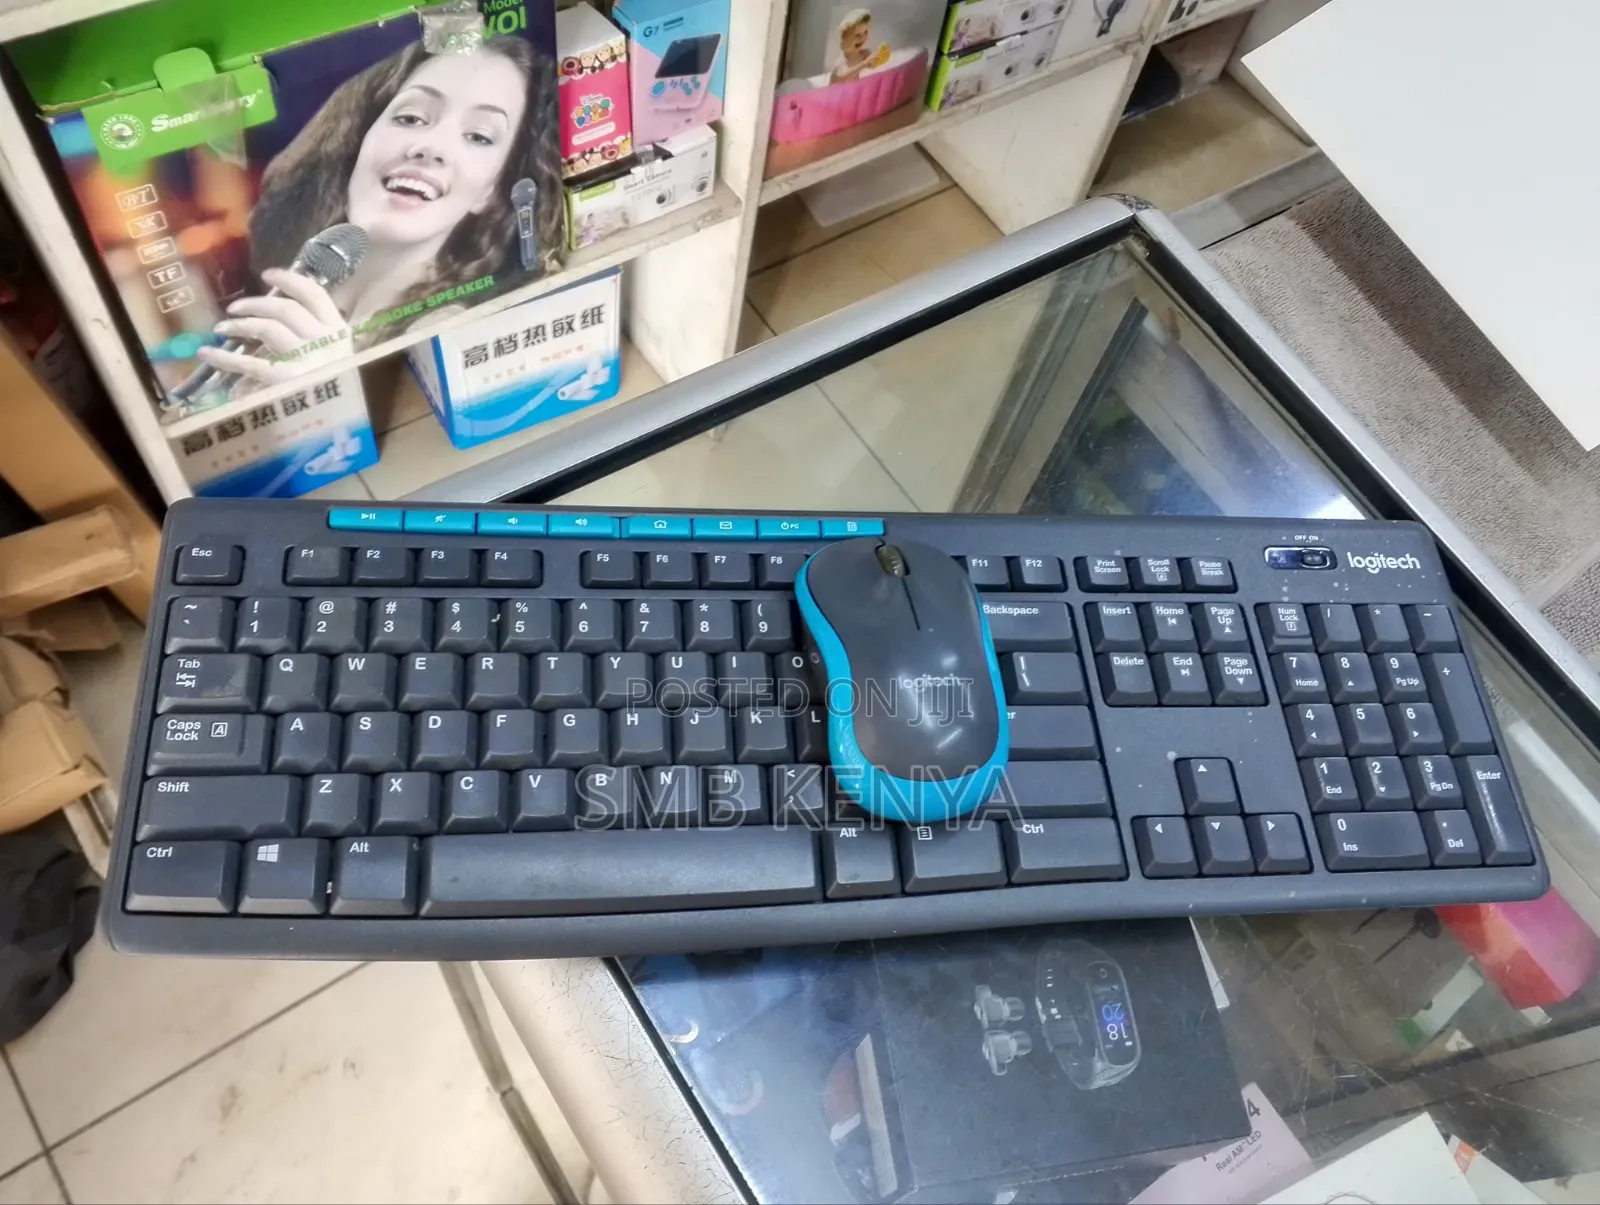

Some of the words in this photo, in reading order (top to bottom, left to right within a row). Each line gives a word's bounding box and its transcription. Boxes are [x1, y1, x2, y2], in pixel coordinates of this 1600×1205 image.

[154, 266, 177, 283] TF
[426, 275, 494, 307] SPEAKER
[462, 303, 606, 369] 高档热敏纸
[192, 548, 212, 557] Esc
[301, 550, 314, 558] F1
[366, 550, 380, 558] F2
[431, 551, 445, 560] F3
[494, 552, 508, 560] F4
[596, 554, 610, 562] F5
[656, 555, 668, 563] F6
[714, 556, 726, 564] F7
[770, 556, 783, 564] F8
[972, 559, 988, 568] F11
[1026, 559, 1042, 568] F12
[1097, 559, 1115, 567] Print
[1346, 551, 1421, 574] logitech
[1151, 565, 1170, 573] Lock
[1201, 568, 1224, 576] Break
[318, 601, 335, 614] @
[385, 601, 397, 614] #
[451, 602, 460, 615] $
[515, 602, 528, 614] %
[639, 603, 650, 613] &
[983, 604, 1039, 615] Backspace
[1103, 606, 1132, 615] Insert
[1155, 606, 1184, 615] Home
[1210, 606, 1235, 617] Page
[1218, 616, 1232, 626] Up
[1279, 614, 1298, 622] Lock
[250, 620, 259, 633] 1
[316, 620, 327, 633] 2
[384, 620, 395, 633] 3
[451, 621, 462, 633] 4
[514, 621, 525, 633] 5
[578, 621, 589, 633] 6
[640, 621, 650, 633] 7
[700, 621, 710, 633] 8
[758, 622, 768, 633] 9
[177, 658, 200, 669] Tab
[279, 658, 293, 672] Q
[348, 658, 366, 671] W
[415, 657, 427, 670] E
[481, 657, 494, 670] R
[547, 656, 558, 670] T
[610, 656, 622, 669] Y
[671, 656, 684, 669] U
[732, 656, 737, 668] I
[792, 656, 804, 669] O
[1113, 657, 1144, 666] Delete
[1172, 657, 1193, 666] End
[1224, 657, 1248, 667] Page
[1289, 658, 1298, 668] 7
[1340, 658, 1350, 668] 8
[1390, 658, 1400, 668] 9
[1224, 666, 1252, 676] Down
[1296, 678, 1320, 687] Home
[1396, 678, 1406, 687] Pg
[1407, 678, 1420, 686] Up
[626, 712, 640, 726] H
[690, 712, 700, 725] J
[750, 711, 762, 724] K
[811, 710, 821, 723] L
[1305, 708, 1315, 720] 4
[1356, 708, 1366, 720] 5
[1406, 708, 1416, 720] 6
[167, 719, 201, 732] Caps
[290, 718, 304, 732] A
[359, 716, 372, 731] S
[428, 715, 442, 729] D
[496, 714, 507, 728] F
[563, 714, 576, 727] G
[166, 730, 199, 741] Lock
[1320, 762, 1328, 774] 1
[1372, 762, 1382, 774] 2
[1424, 760, 1434, 772] 3
[595, 774, 608, 786] B
[660, 772, 672, 785] N
[1476, 770, 1502, 780] Enter
[158, 781, 190, 793] Shift
[318, 780, 333, 794] Z
[388, 778, 402, 793] X
[460, 776, 474, 790] C
[528, 774, 542, 789] V
[1430, 782, 1441, 792] Pg
[1441, 782, 1454, 790] Dn
[1326, 785, 1342, 794] End
[1022, 824, 1044, 834] Ctrl
[1338, 819, 1347, 831] 0
[839, 827, 858, 838] Alt
[349, 842, 370, 853] Alt
[1342, 842, 1358, 852] Ins
[1448, 838, 1464, 848] Del
[146, 846, 173, 858] Ctrl
[1106, 1022, 1128, 1041] 18
[1246, 1098, 1261, 1118] 4
[1215, 1153, 1233, 1172] Real
[1231, 1130, 1262, 1159] AMLED
